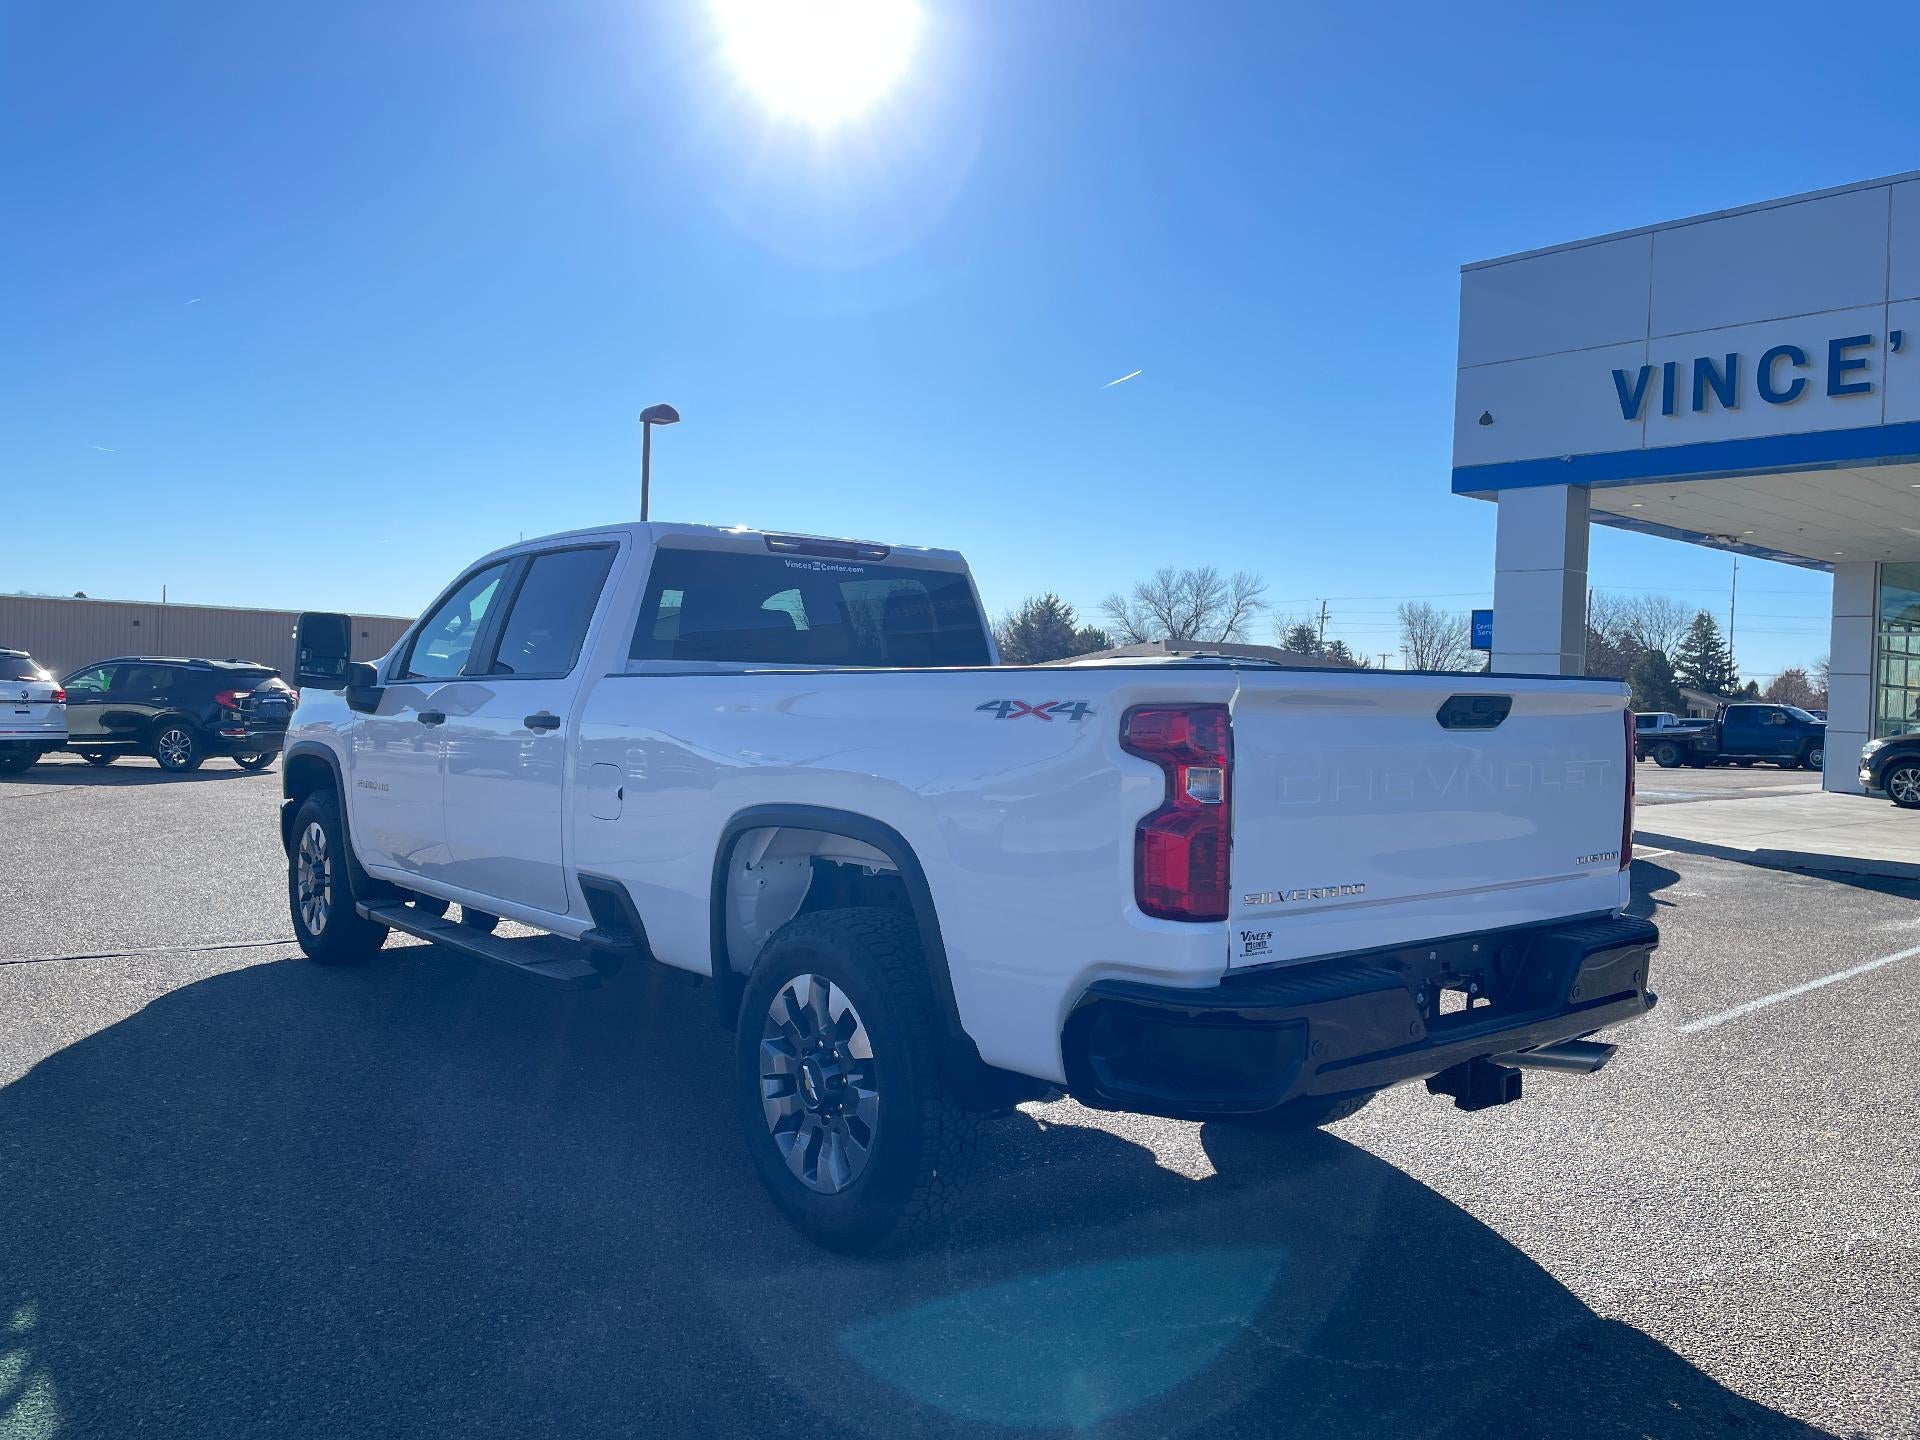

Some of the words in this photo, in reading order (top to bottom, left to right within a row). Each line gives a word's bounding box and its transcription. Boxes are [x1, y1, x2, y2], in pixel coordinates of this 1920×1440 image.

[1611, 330, 1904, 420] VINCE'
[1279, 758, 1612, 805] CHEVROLET
[1243, 883, 1366, 906] SILVERADO
